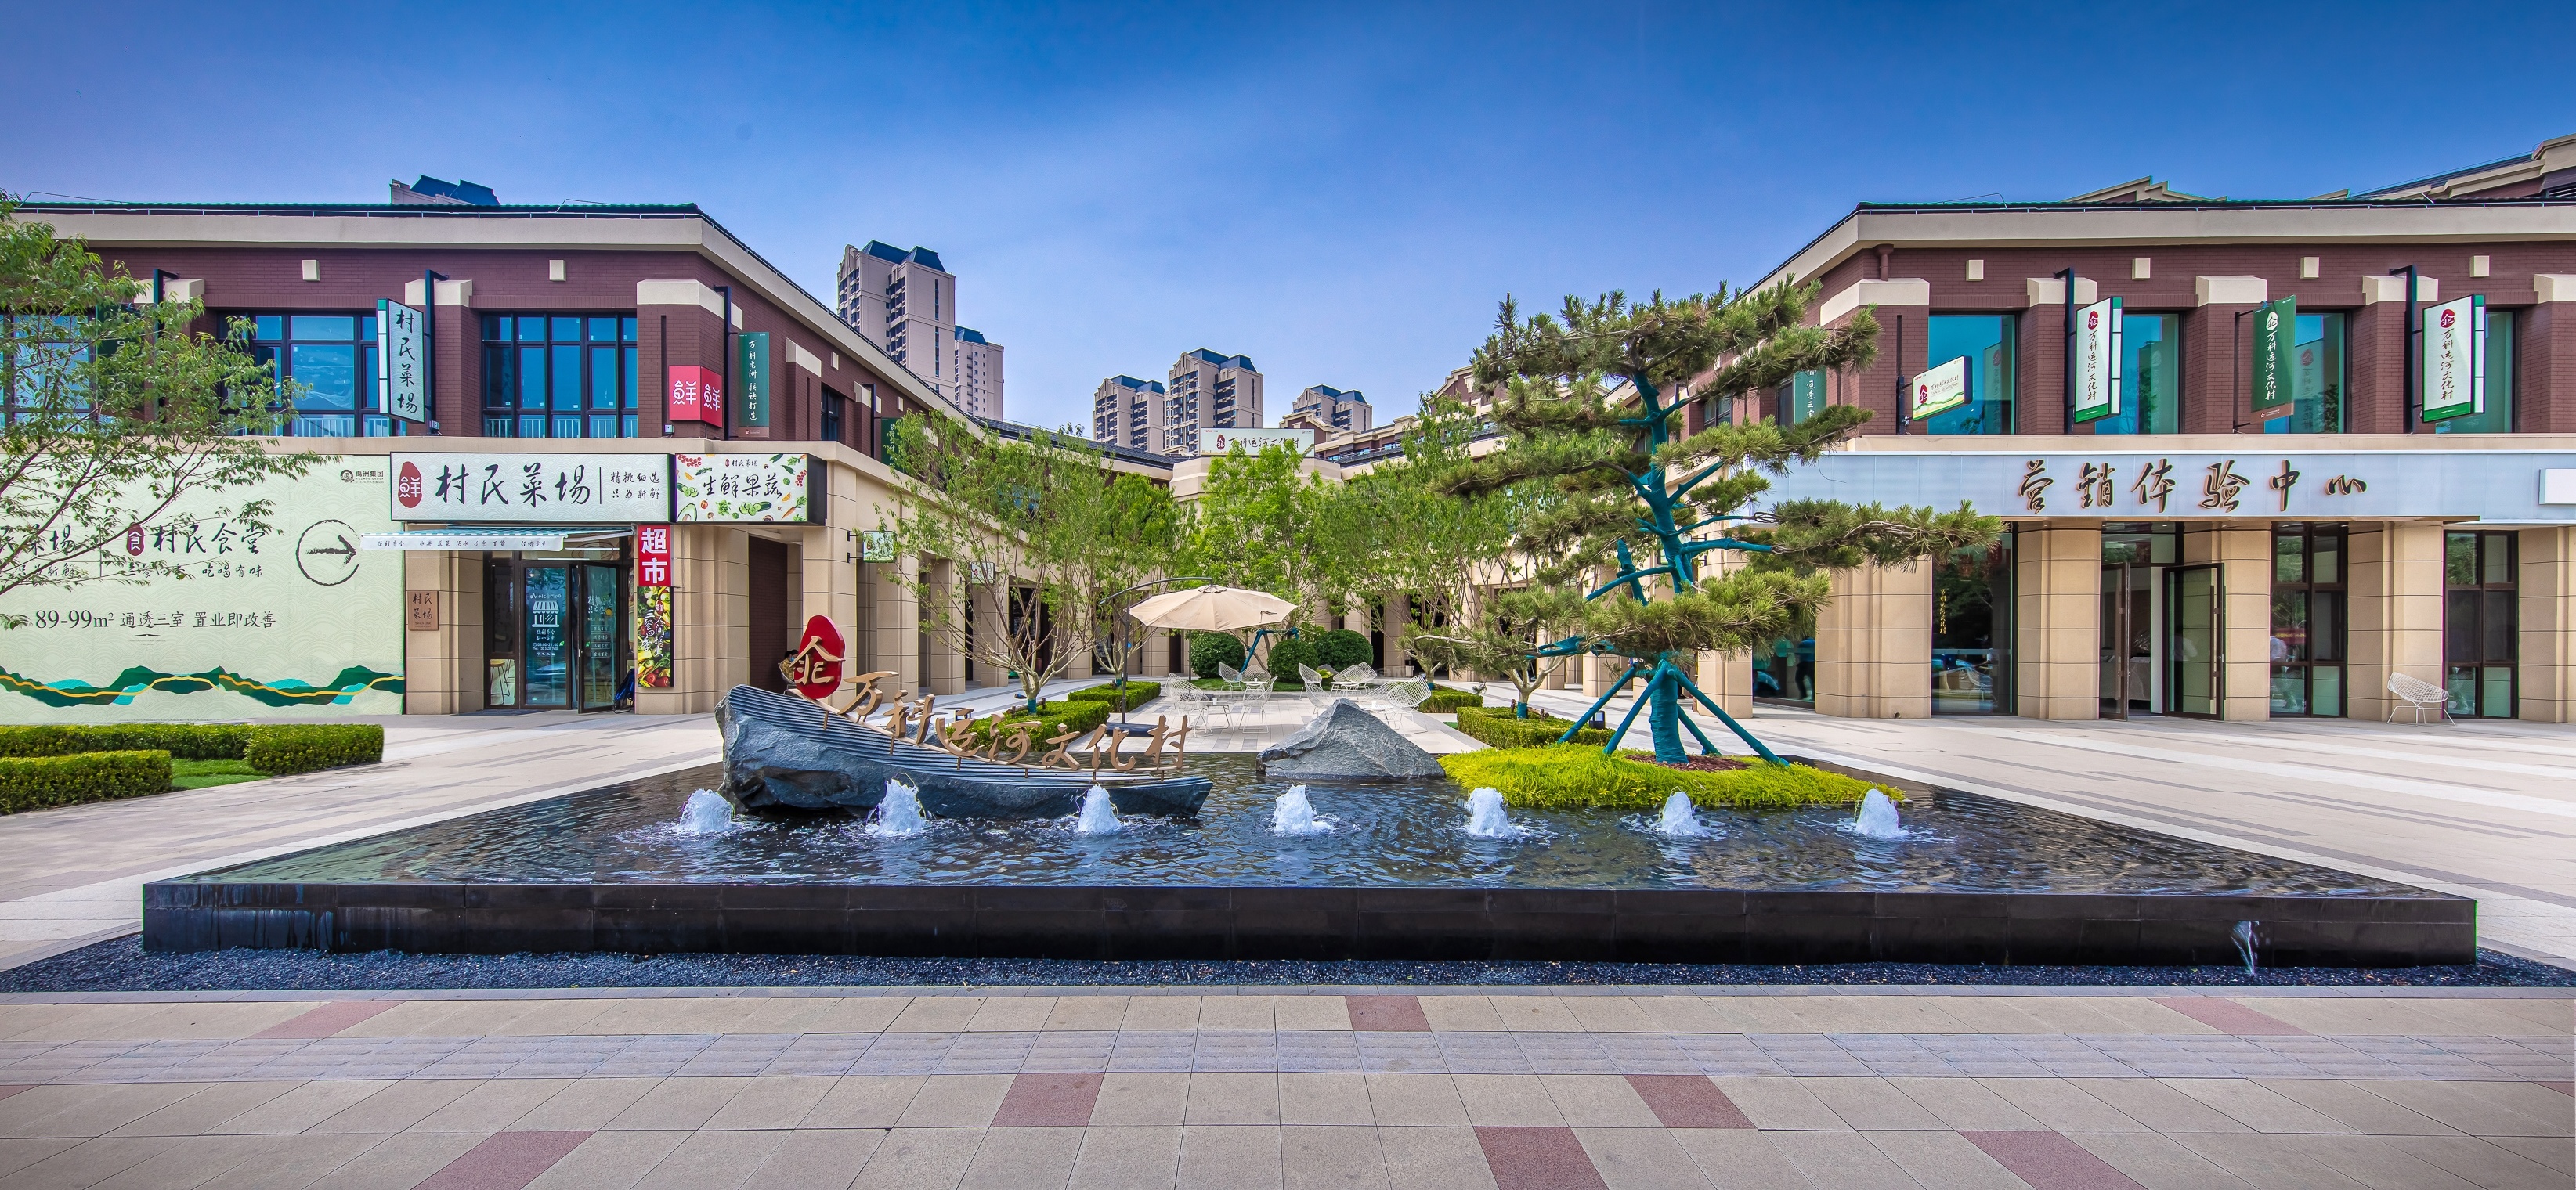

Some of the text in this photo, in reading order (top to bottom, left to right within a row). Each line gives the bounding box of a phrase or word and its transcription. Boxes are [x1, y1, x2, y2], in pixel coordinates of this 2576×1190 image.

[2087, 330, 2098, 401] 万科运河文化村
[2265, 330, 2278, 400] 万科运河文化村
[2441, 328, 2455, 400] 万科运河文化村
[611, 471, 660, 485] 精挑细选
[612, 488, 660, 500] 只为新鲜
[703, 473, 782, 499] 生鲜果蔬
[2018, 458, 2368, 514] 营销体验中心
[153, 522, 266, 555] 村民食堂
[641, 528, 667, 583] 超市
[201, 563, 263, 578] 吃喝有味
[120, 611, 186, 628] 通透三室
[193, 611, 276, 628] 置业即改善
[413, 593, 432, 604] 村民
[641, 609, 655, 651] 三餐四季
[655, 615, 665, 657] 人间烟火
[840, 670, 1192, 771] 万科运河文化村
